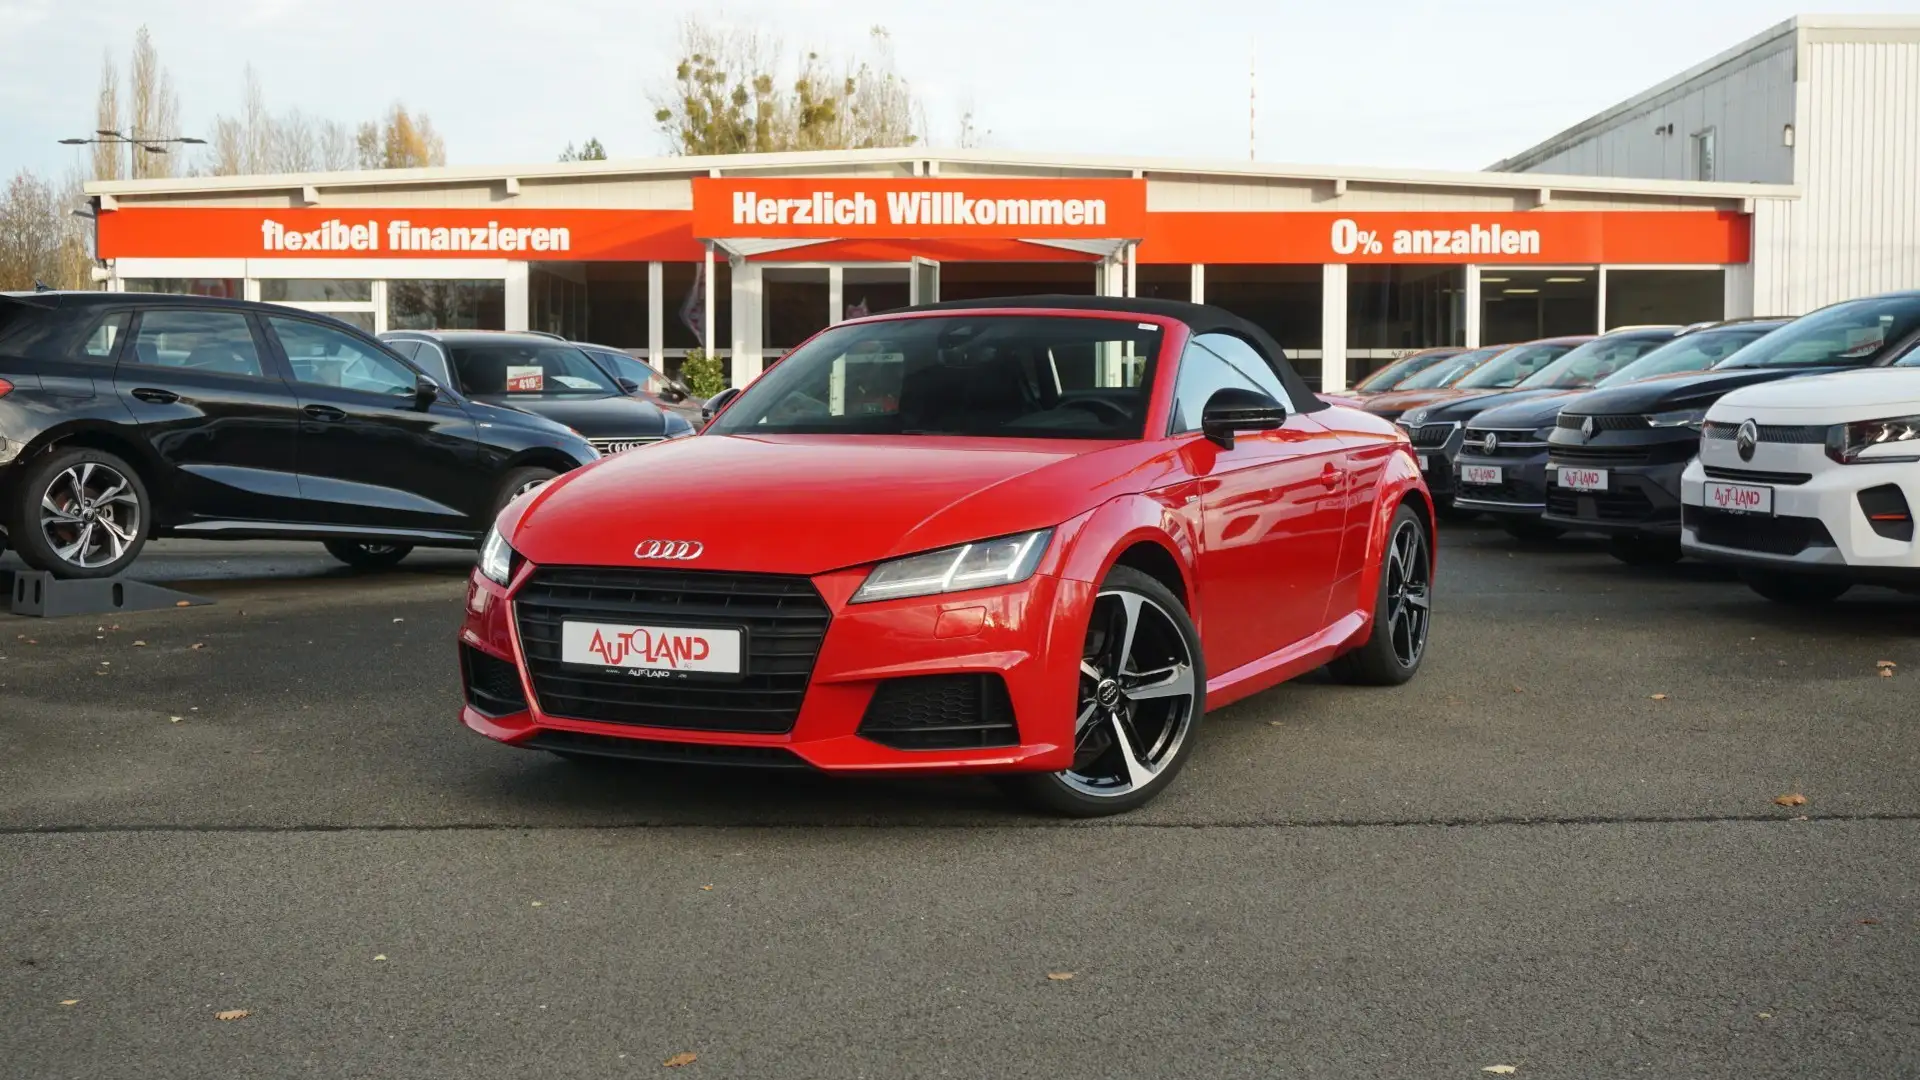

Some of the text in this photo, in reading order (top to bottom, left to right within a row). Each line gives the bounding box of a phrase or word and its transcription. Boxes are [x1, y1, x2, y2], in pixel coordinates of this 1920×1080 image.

[733, 191, 1106, 226] Herzlich Willkommen
[262, 219, 570, 251] flexibel finanzieren
[1331, 218, 1540, 255] 0% anzahlen
[1714, 487, 1760, 509] AUTOLAND
[588, 628, 710, 668] AUTOLAND
[628, 668, 670, 678] AUTOLAND
